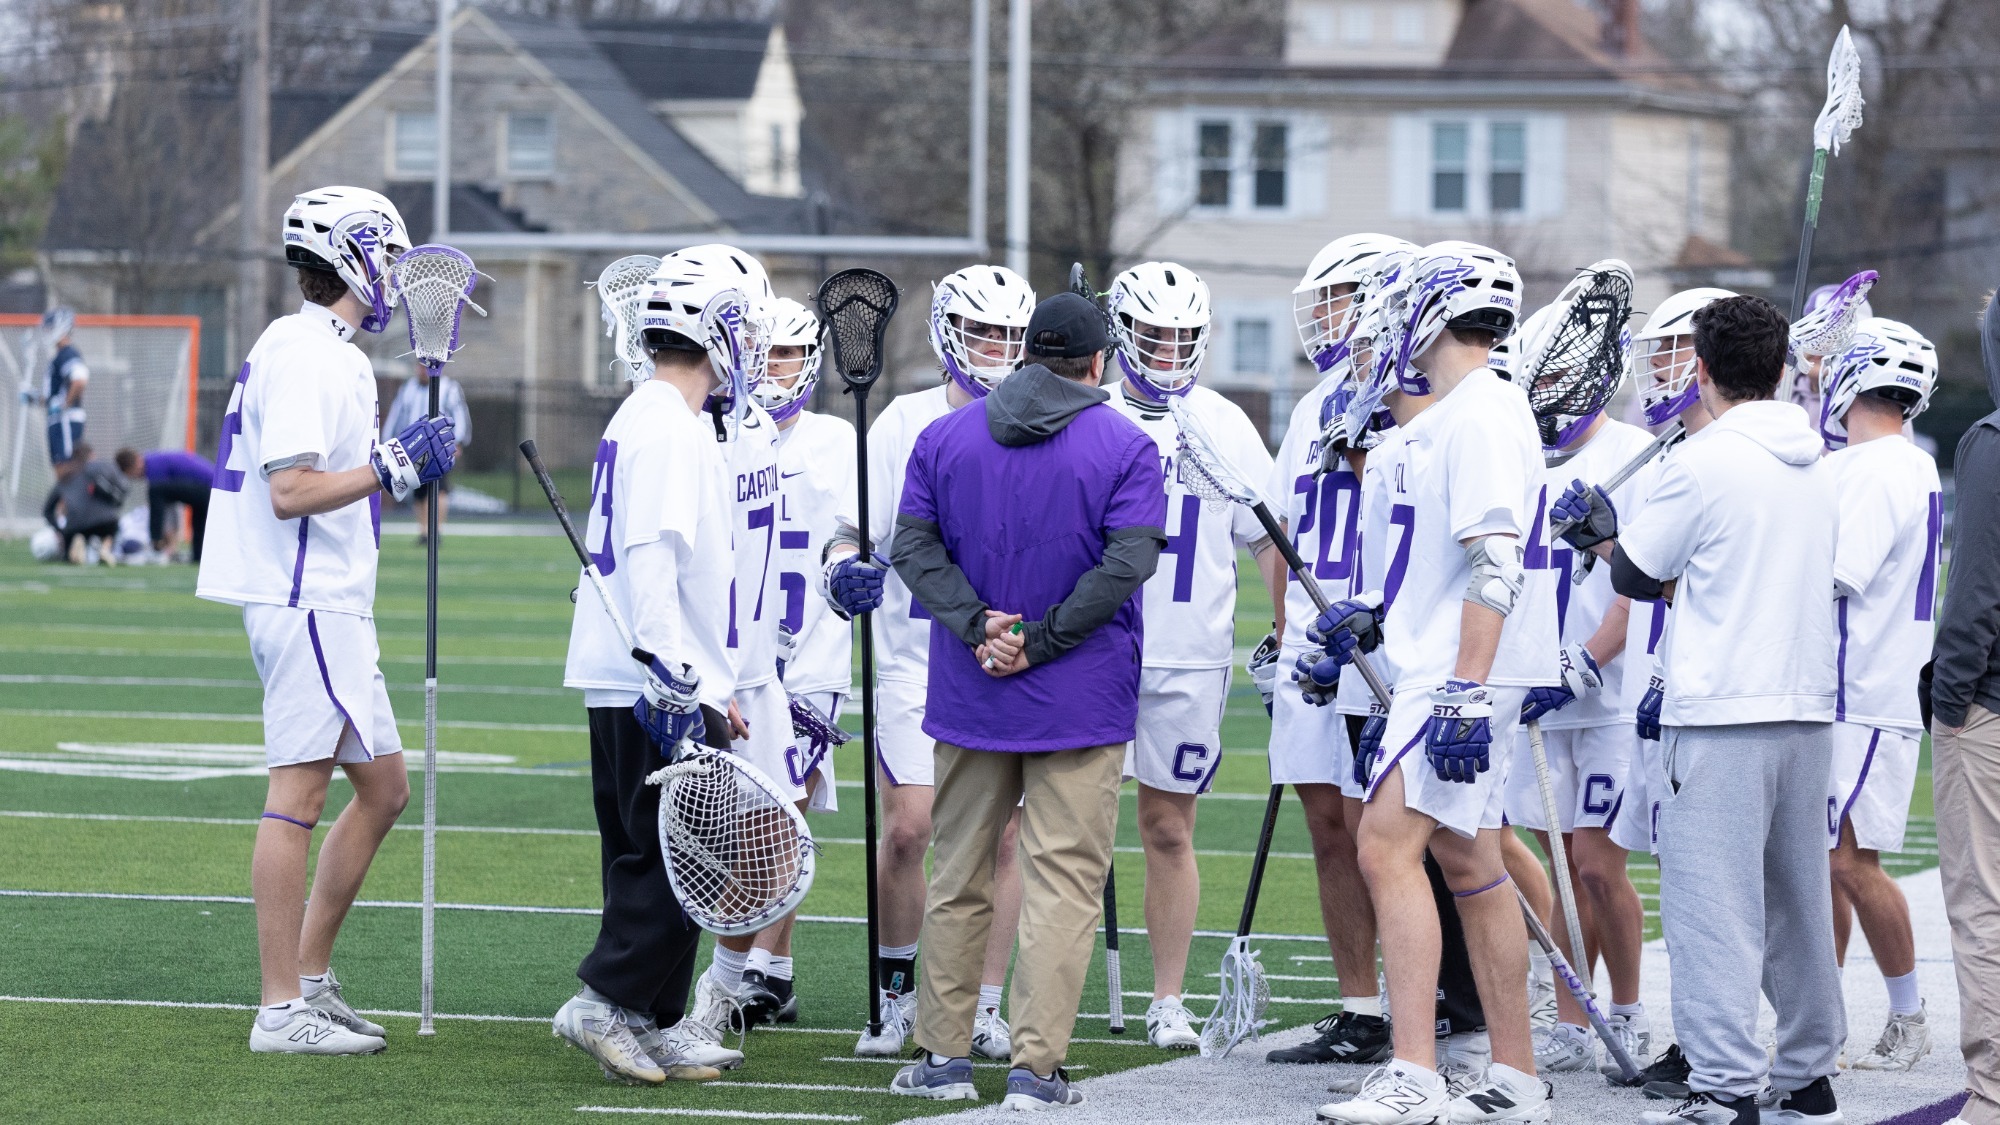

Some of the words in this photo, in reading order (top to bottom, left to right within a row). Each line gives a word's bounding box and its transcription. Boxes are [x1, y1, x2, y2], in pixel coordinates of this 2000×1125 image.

[1490, 295, 1514, 307] CAPITAL
[644, 318, 671, 326] CAPITAL
[1487, 357, 1508, 367] APITAL
[1895, 375, 1923, 388] CAPITAL
[387, 440, 410, 468] STX
[1289, 471, 1361, 583] 20
[656, 698, 690, 715] STX
[1433, 704, 1463, 717] STX
[1171, 742, 1210, 783] C
[1582, 773, 1616, 817] C
